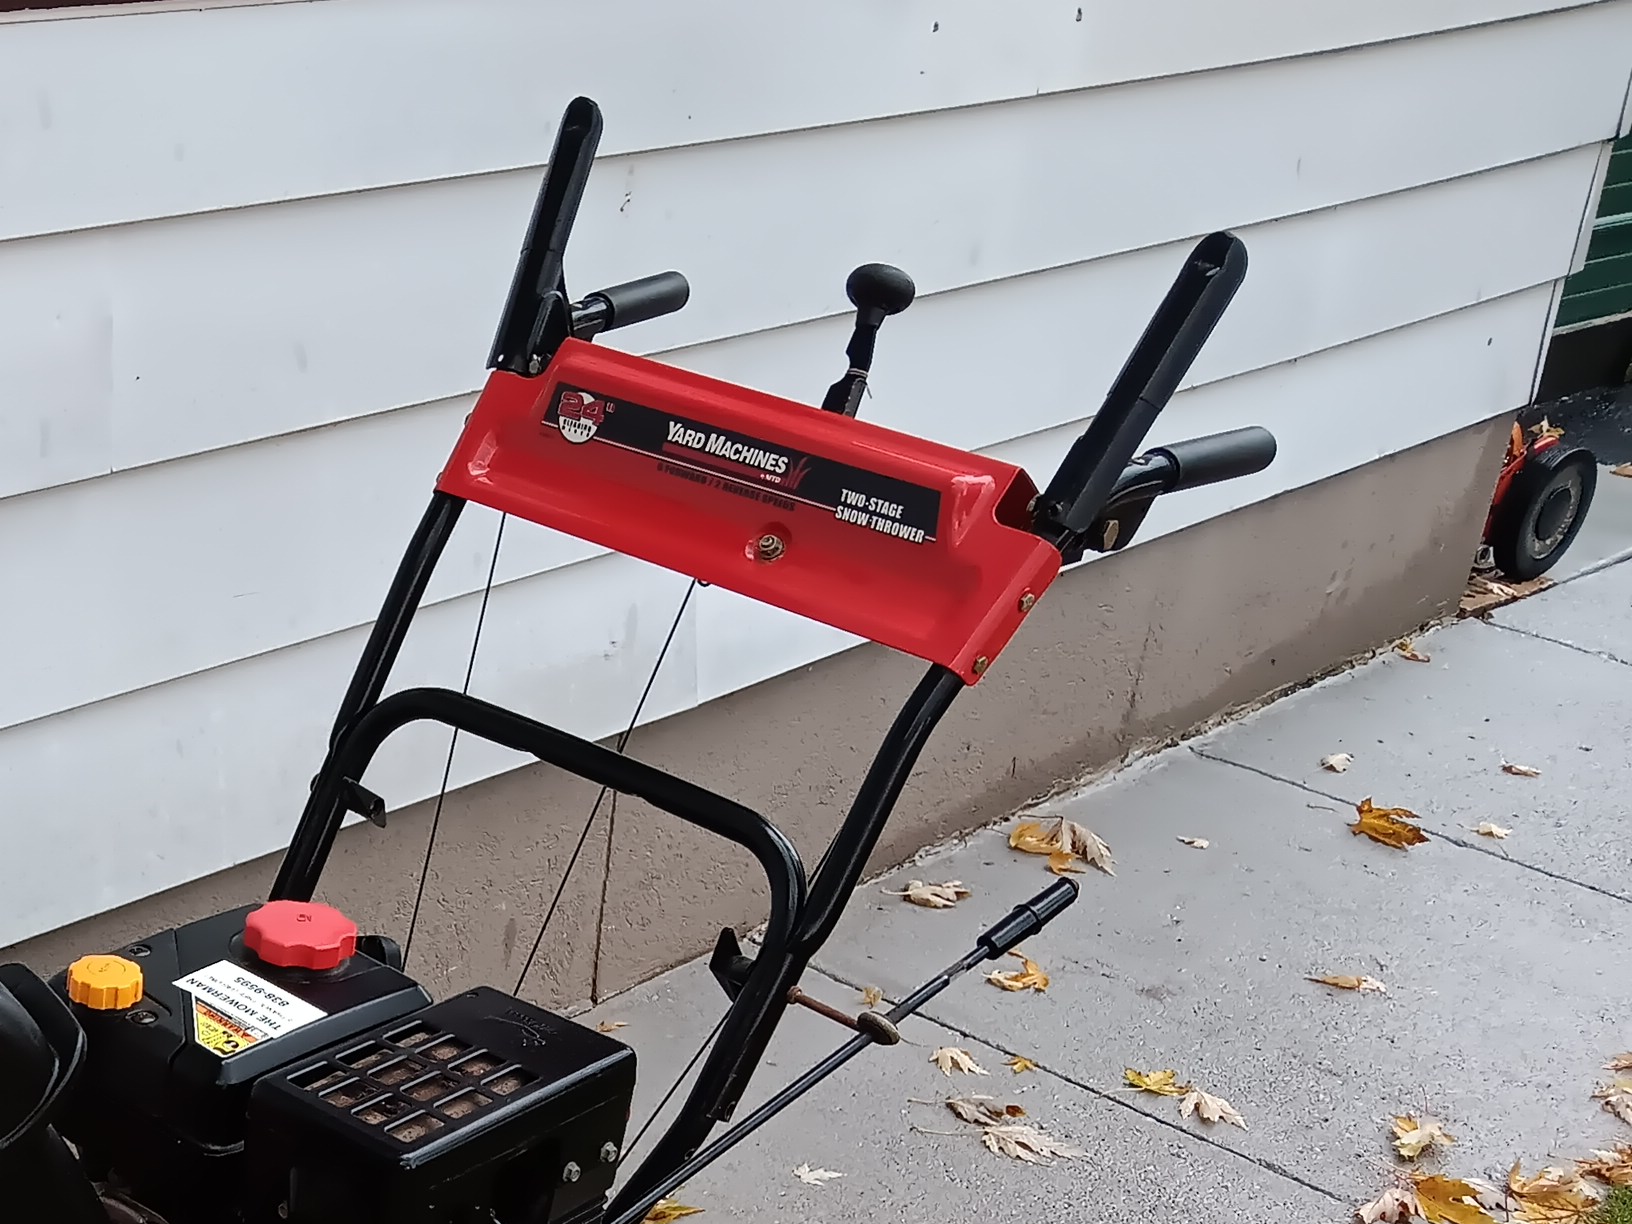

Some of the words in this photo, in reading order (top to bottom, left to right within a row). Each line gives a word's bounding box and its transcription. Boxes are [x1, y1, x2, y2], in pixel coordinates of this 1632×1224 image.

[668, 421, 706, 449] YARD
[705, 433, 789, 474] MACHINES
[186, 978, 257, 1017] MOWERMAN
[233, 976, 290, 1007] 838-9595
[255, 1014, 282, 1031] THE
